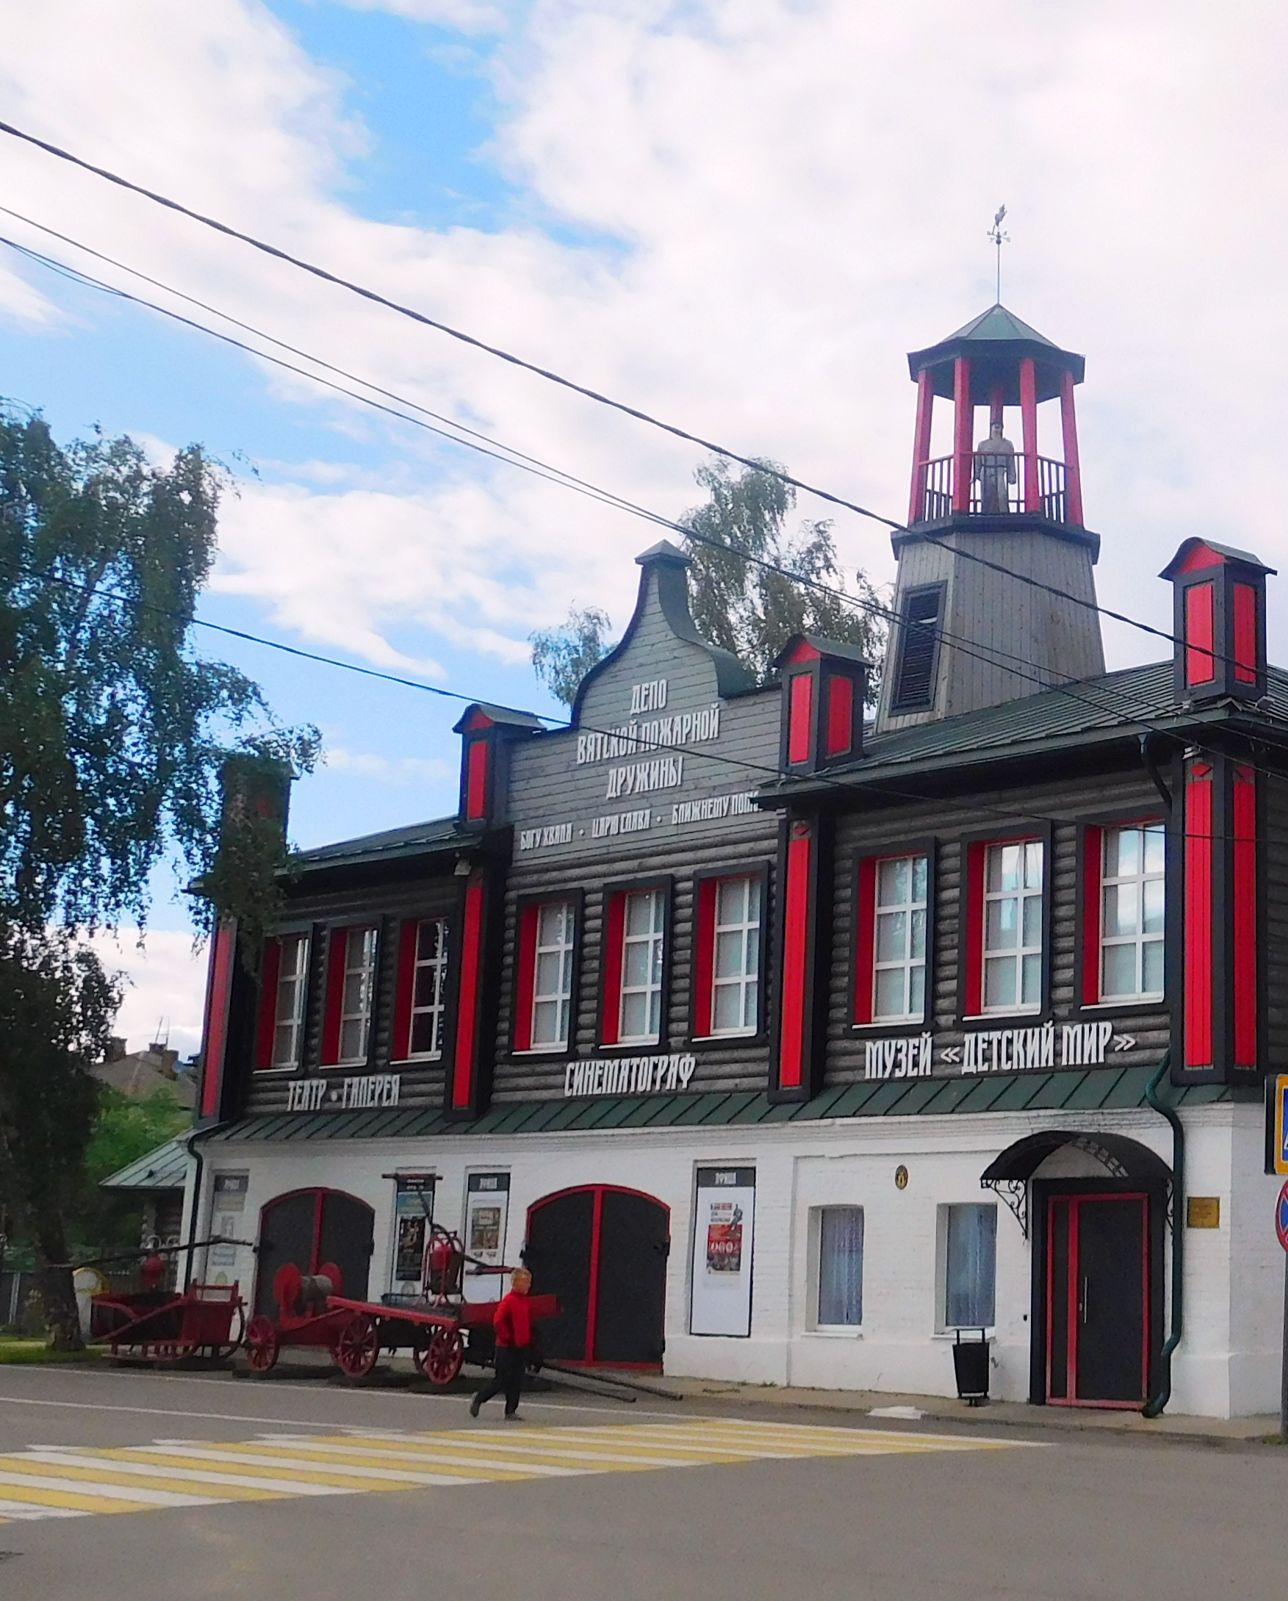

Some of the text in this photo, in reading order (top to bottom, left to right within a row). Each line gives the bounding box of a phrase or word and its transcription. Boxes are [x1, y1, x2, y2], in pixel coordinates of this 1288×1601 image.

[630, 679, 668, 715] ДЕПО
[576, 703, 720, 764] ВЯТСКОЙ ПОЖАРНОЙ
[606, 755, 684, 800] ДРУЖИНЫ
[520, 829, 542, 850] БОГУ
[541, 823, 573, 847] ХВАЛА
[592, 815, 619, 838] ЦАРЮ
[619, 809, 651, 834] СЛАВА
[672, 795, 730, 825] БЛИЖНЕМУ
[865, 1020, 1136, 1079] МУЗЕЙ «ДЕТСКИЙ МИР»
[287, 1075, 400, 1111] ТЕАТР ГАЛЕРЕЯ
[564, 1053, 696, 1097] СИНЕМАТОГРАФ
